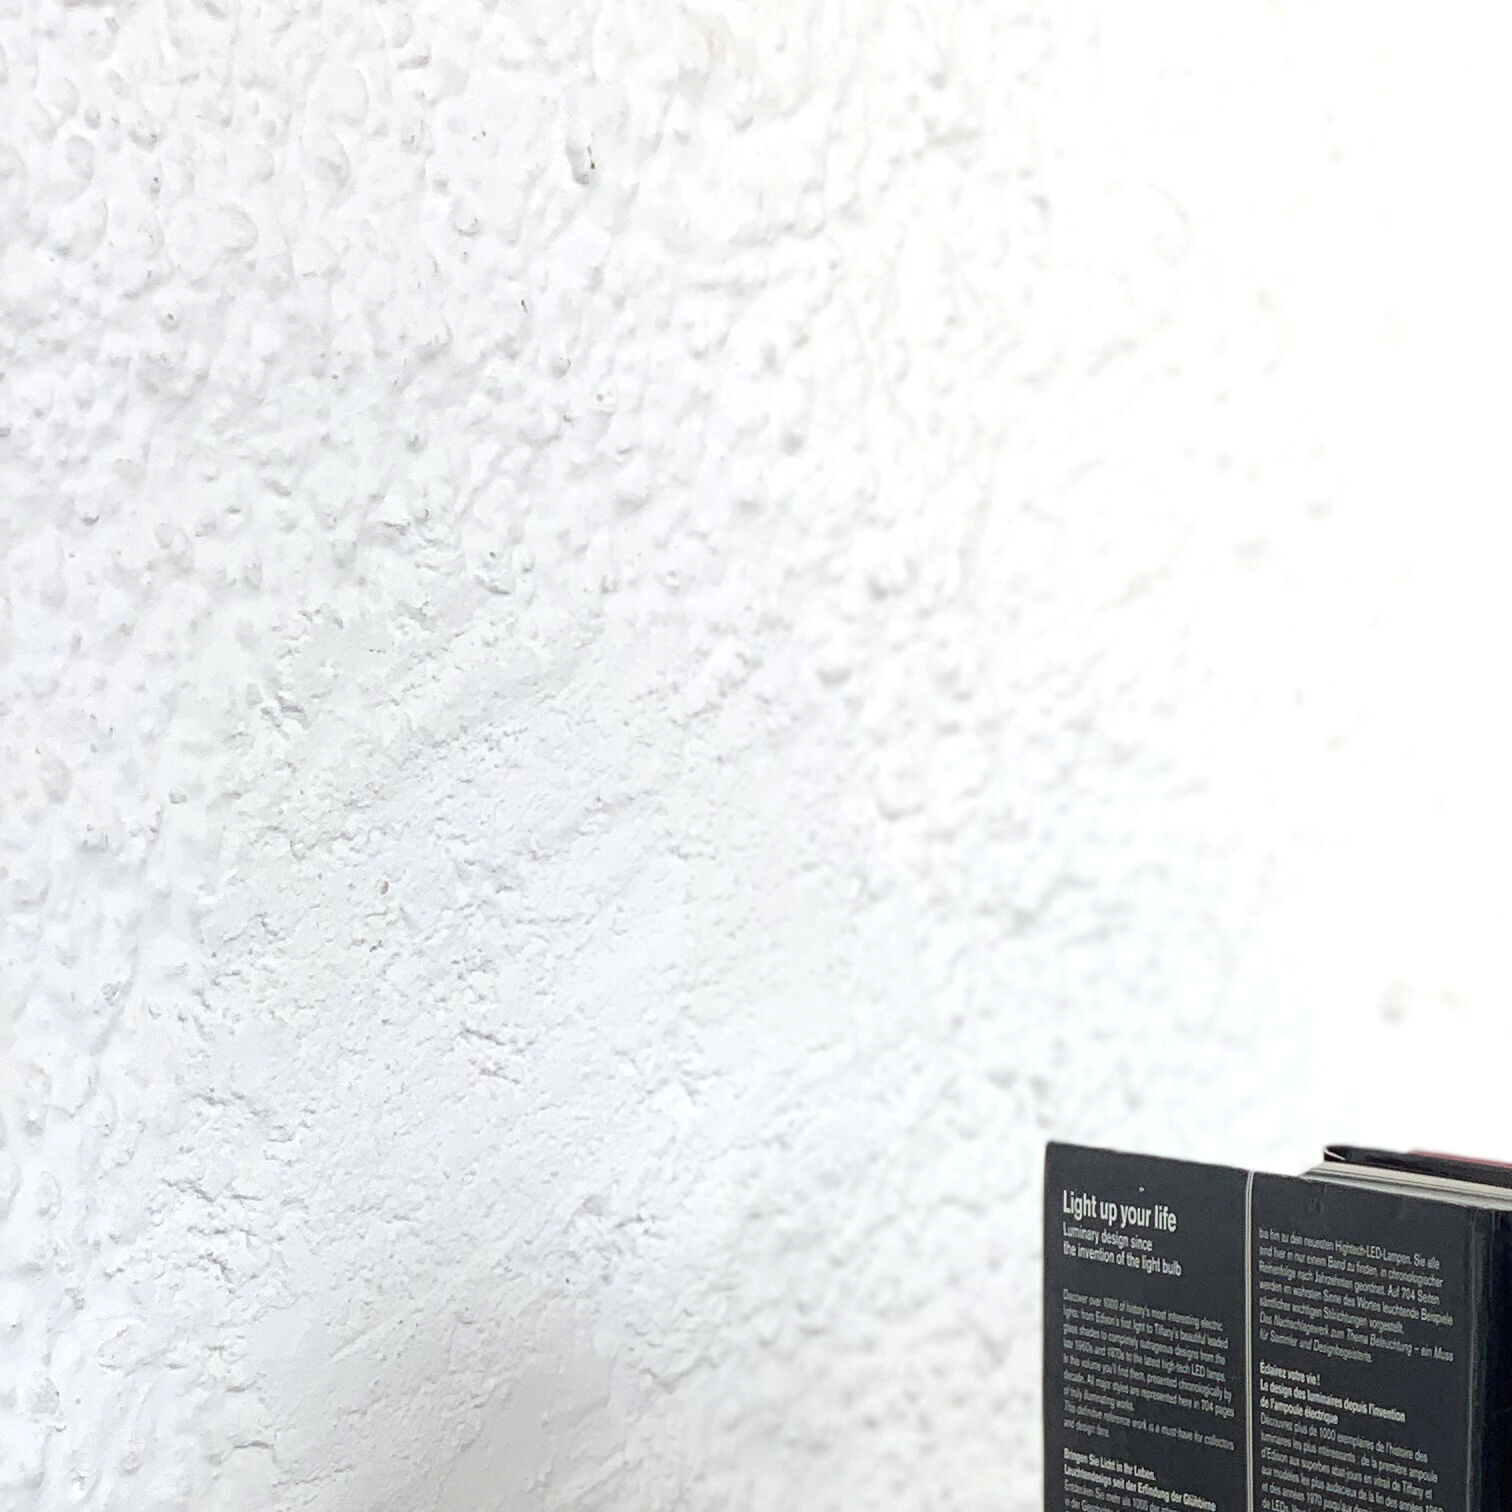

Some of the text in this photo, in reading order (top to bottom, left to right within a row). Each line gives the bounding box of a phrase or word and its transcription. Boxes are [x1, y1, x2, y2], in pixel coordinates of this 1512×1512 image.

[1063, 1189, 1176, 1232] Light up your life
[1063, 1222, 1152, 1251] Luminary design since
[1063, 1240, 1181, 1276] the invention of the light bulb
